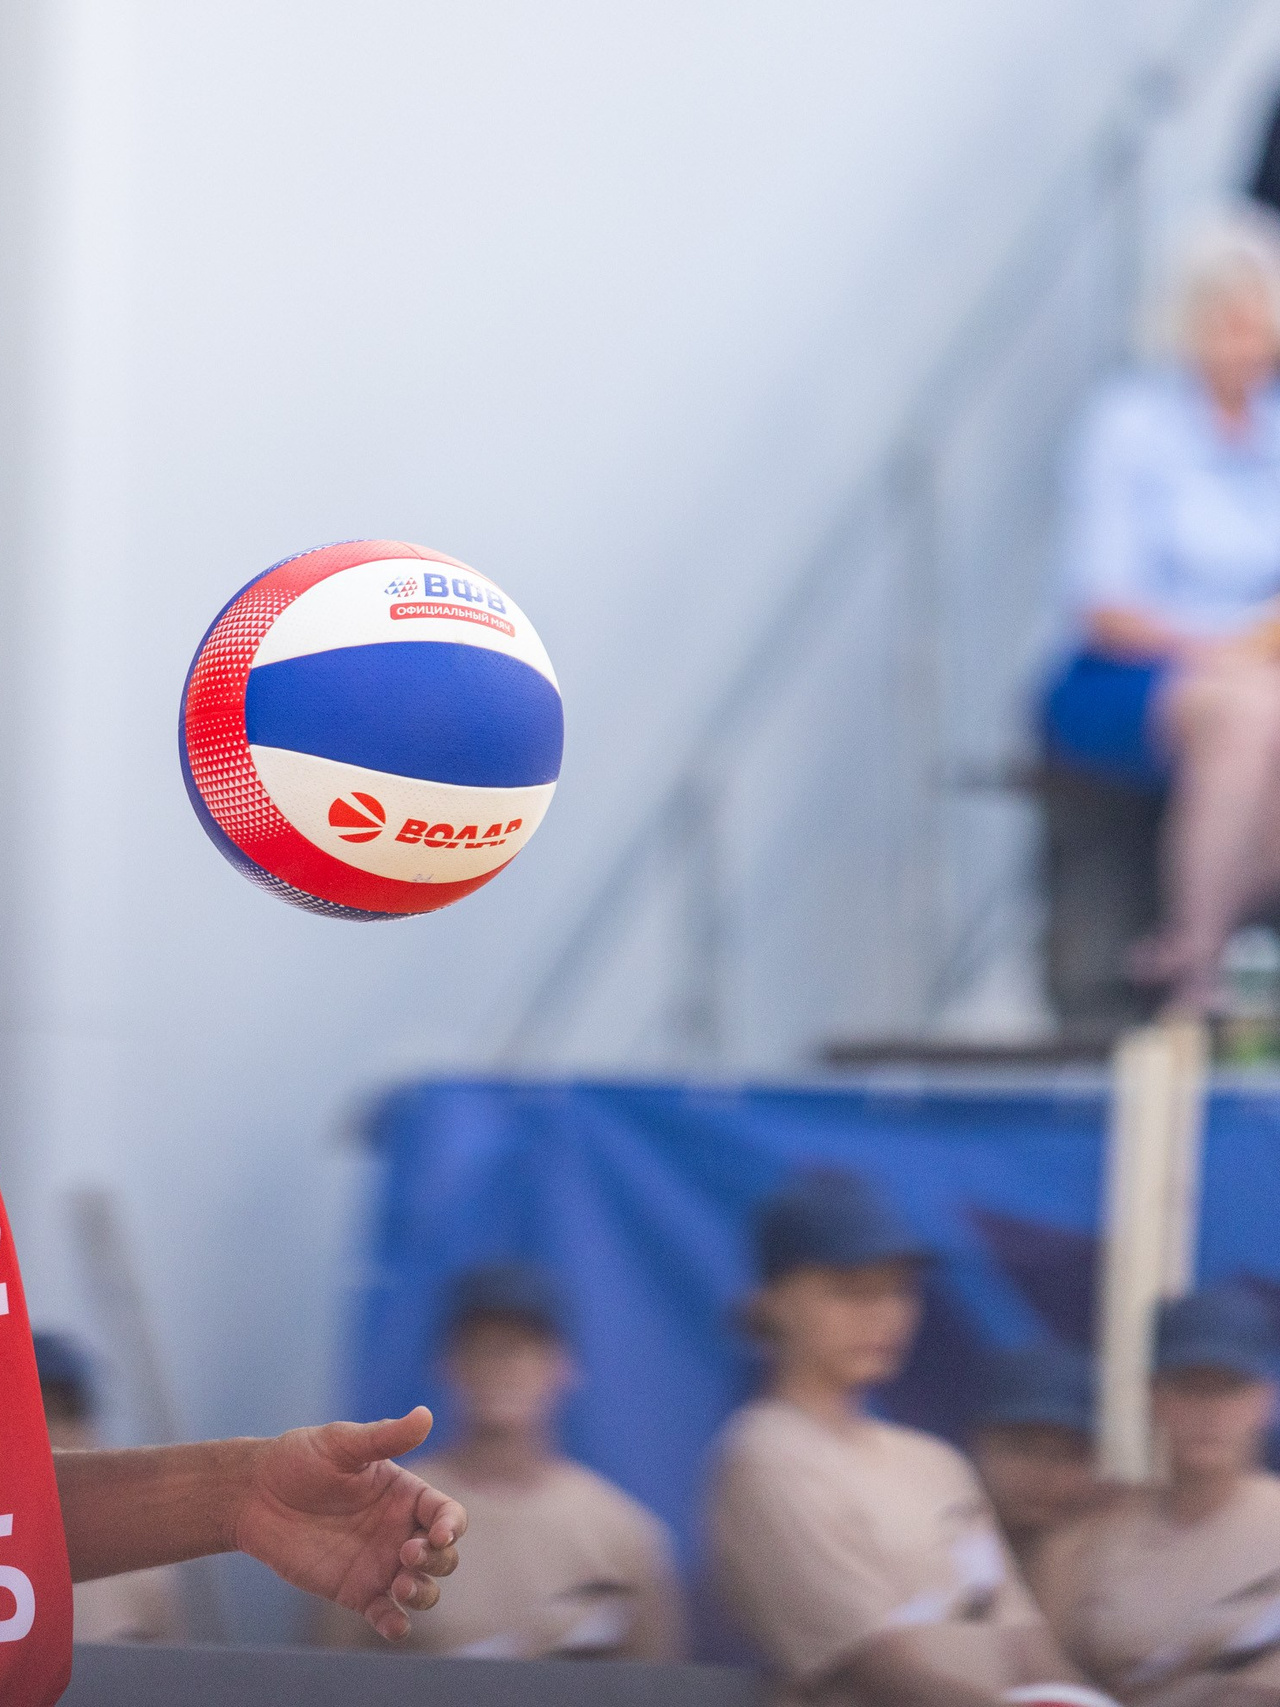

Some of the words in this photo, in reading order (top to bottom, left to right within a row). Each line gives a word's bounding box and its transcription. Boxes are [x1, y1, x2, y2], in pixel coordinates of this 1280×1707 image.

[423, 573, 506, 614] ВФВ
[396, 606, 489, 624] ОФИЦИАЛЬНЫЙ
[490, 617, 512, 633] МЯЧ
